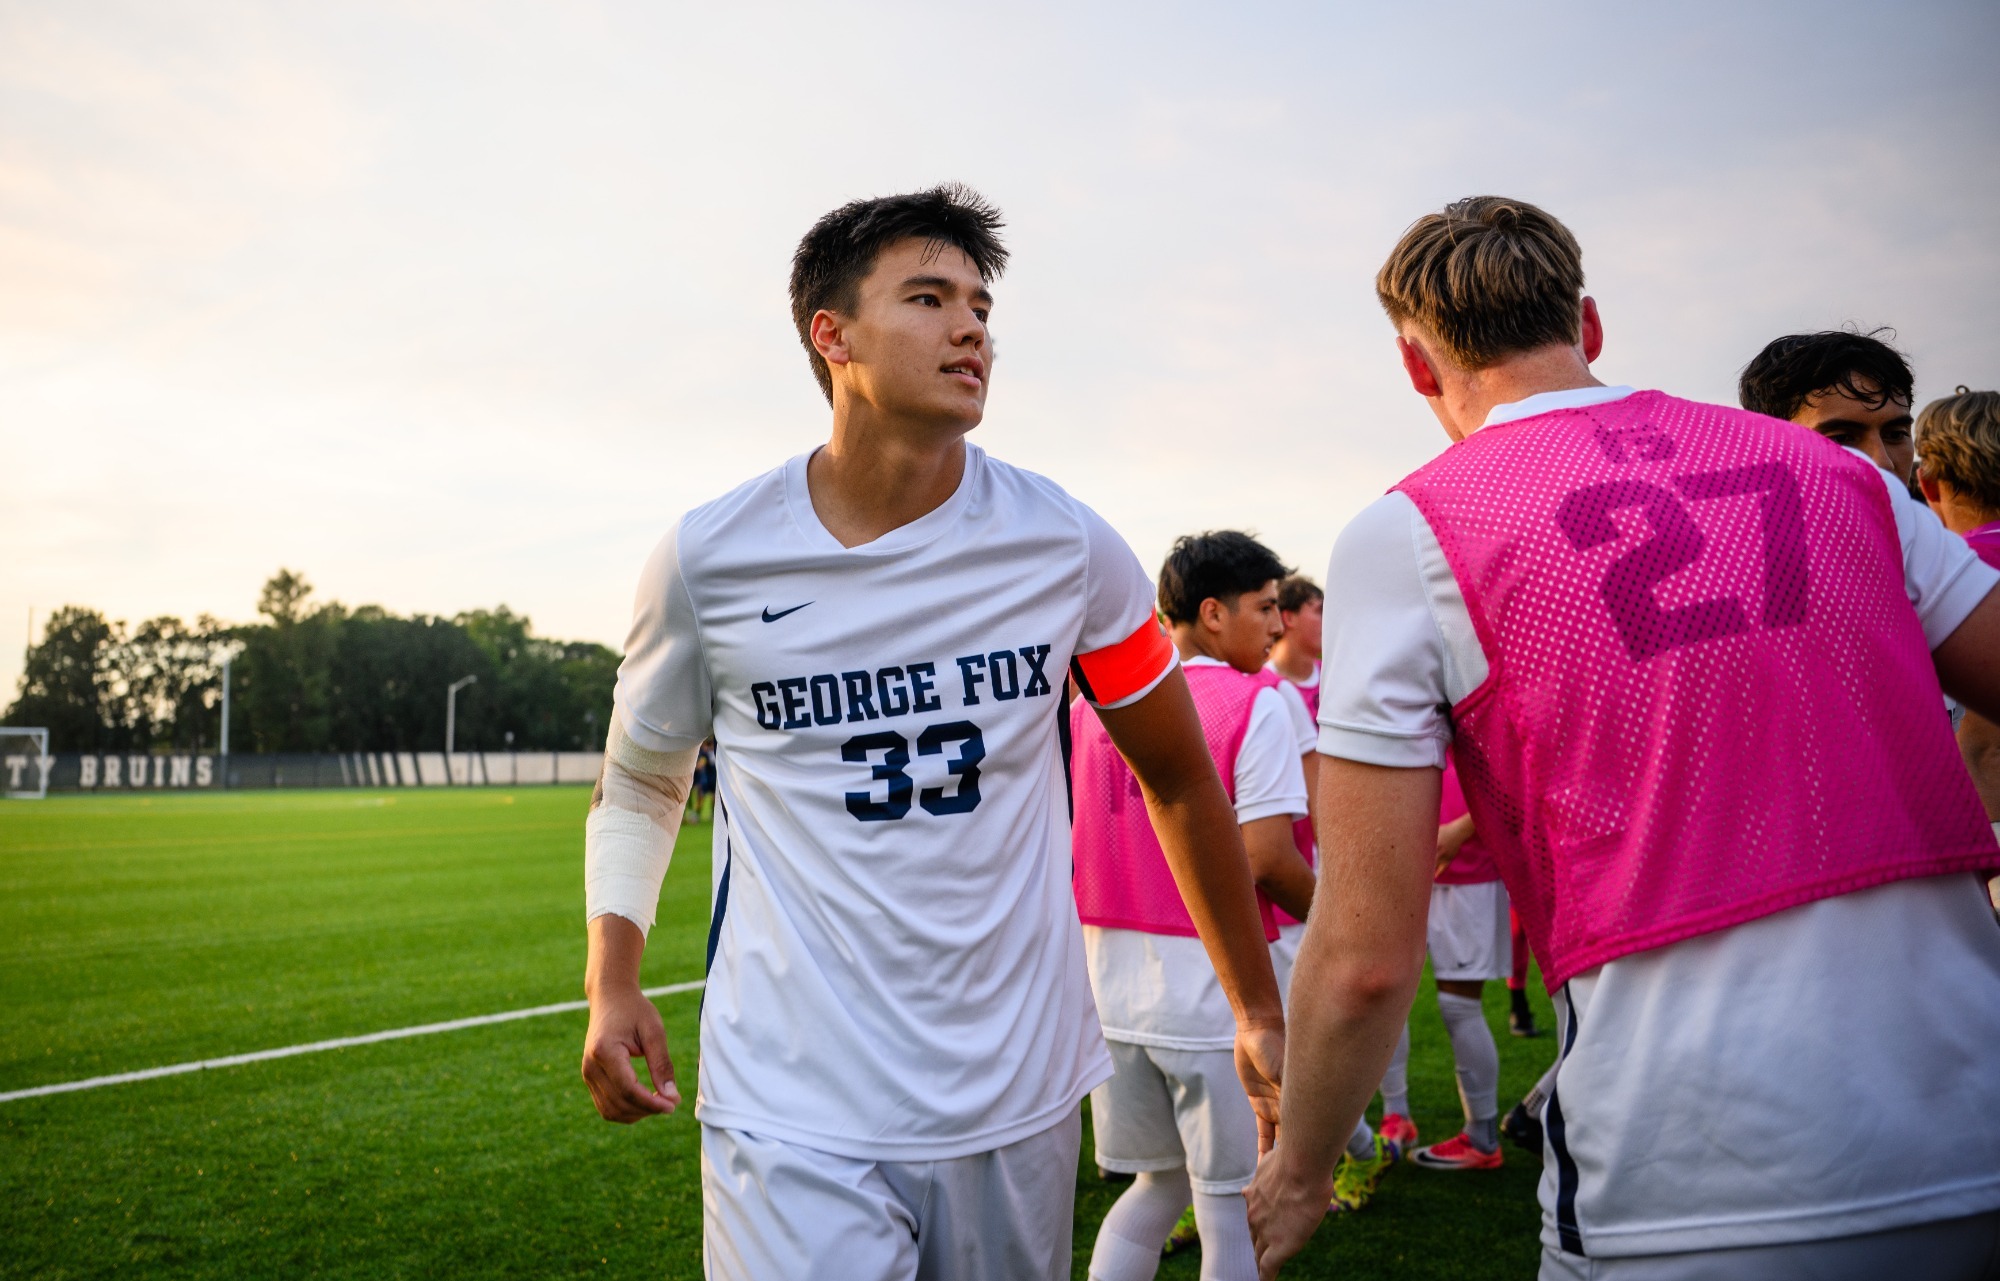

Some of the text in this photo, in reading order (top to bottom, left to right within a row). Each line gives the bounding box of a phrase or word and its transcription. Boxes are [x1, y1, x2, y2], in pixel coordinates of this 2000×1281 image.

[1555, 461, 1808, 663] 27
[751, 644, 1051, 731] GEORGE FOX
[79, 755, 213, 787] BRUINS
[841, 720, 986, 822] 33
